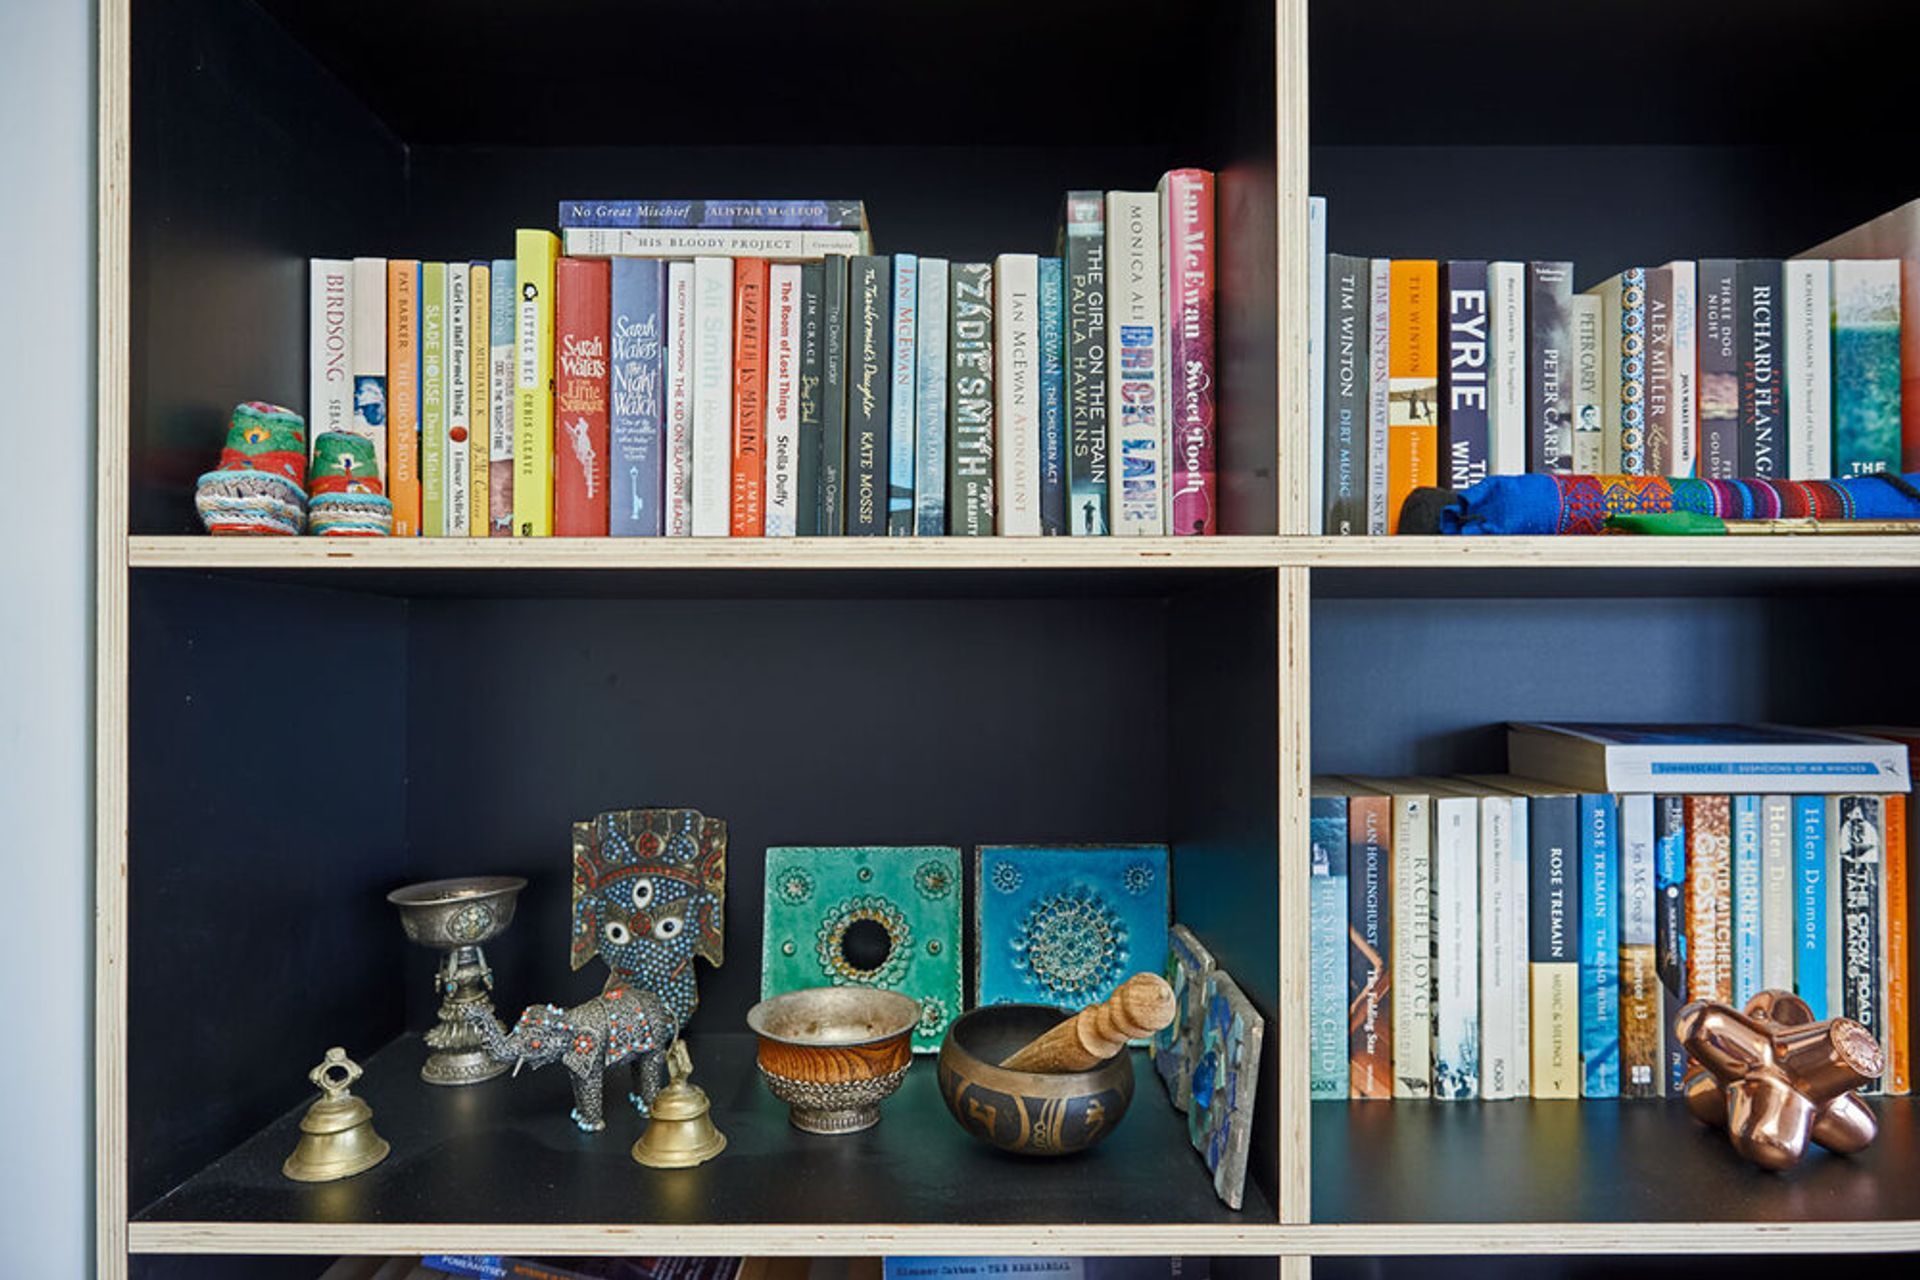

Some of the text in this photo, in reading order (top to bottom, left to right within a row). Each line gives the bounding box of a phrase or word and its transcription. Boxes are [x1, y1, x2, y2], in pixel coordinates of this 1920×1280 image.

[572, 205, 691, 218] No Great Mischief
[710, 206, 762, 217] ALISTAIR
[638, 238, 791, 249] HIS BLOODY PROJECT
[807, 292, 816, 315] JIM
[864, 269, 876, 284] The
[1045, 281, 1057, 308] IAN
[326, 274, 345, 382] BIRDSONG
[398, 272, 408, 347] PAT BARKER
[616, 314, 655, 339] Sarah
[1409, 276, 1421, 373] TIM WINTON
[1708, 294, 1718, 340] NIGHT
[1721, 277, 1732, 357] THREE DOG
[1753, 286, 1771, 382] RICHARD
[427, 305, 439, 405] SLADE HOUSE
[453, 283, 464, 416] Girl formed Thing
[613, 337, 657, 361] Waters
[703, 320, 723, 389] Smith
[741, 284, 759, 456] ELIZABETH MISSING
[777, 282, 792, 421] The Room of Lost Things
[807, 322, 816, 365] CRACE
[829, 305, 839, 384] The Devil's Larder
[1072, 274, 1088, 457] PAULA HAWKINS
[1087, 244, 1105, 483] THE GIRL ON THE TRAIN
[1120, 205, 1156, 521] MONICA ALI BRICK LANE
[1178, 181, 1210, 499] Ian McEwan Sweet Tooth
[1451, 289, 1486, 410] EYRIE
[1580, 313, 1596, 394] PETER CAREY
[1651, 300, 1666, 416] ALEX MILLER
[476, 347, 485, 402] MICHAEL
[523, 306, 533, 476] LITTLE BEE CHRIS CLEAVE
[614, 364, 656, 399] Night
[615, 390, 656, 417] Watch
[674, 378, 685, 397] THE
[857, 363, 877, 419] Daughter
[1047, 387, 1056, 406] THE
[1339, 275, 1355, 497] TIM WINTON DIRT MUSIC
[1373, 273, 1387, 518] TIM WINTON THAT EYE, THE SKY
[673, 423, 684, 443] ON
[674, 401, 685, 420] KID
[956, 281, 987, 536] ZADIE SMITH ON BEAUTY
[1047, 410, 1057, 460] CHILDREN
[1543, 349, 1559, 467] PETER CAREY
[673, 446, 684, 495] SLAPTON
[773, 435, 789, 506] Stella Duffy
[860, 432, 873, 468] KATE
[1047, 463, 1057, 484] ACT
[673, 498, 683, 535] BEACH
[735, 472, 745, 532] HEALEY
[747, 481, 757, 524] EMMA
[825, 485, 836, 513] Crace
[859, 474, 873, 524] MOSSE
[1366, 810, 1377, 843] ALAN
[1669, 807, 1683, 835] High
[1769, 805, 1786, 857] Helen
[1630, 841, 1645, 864] Jon
[1662, 836, 1675, 880] Fidelity
[1739, 811, 1758, 934] NICK HORNBY
[1805, 808, 1819, 949] Helen Dunmore
[1366, 846, 1378, 947] HOLLINGHURST
[1593, 808, 1607, 982] ROSE TREMAIN The ROAD
[1716, 836, 1730, 981] DAVID MITCHELL
[1847, 871, 1857, 979] IAIN BANKS
[1413, 856, 1429, 1022] RACHEL JOYCE
[1550, 848, 1563, 1069] ROSE TREMAIN MUSIC SILENCE
[1858, 872, 1870, 1024] THE CROW ROAD
[1322, 877, 1338, 1072] THE STRANGER'S CHILD
[1367, 970, 1377, 988] The
[1365, 992, 1377, 1031] Folding
[1367, 1033, 1377, 1054] Star
